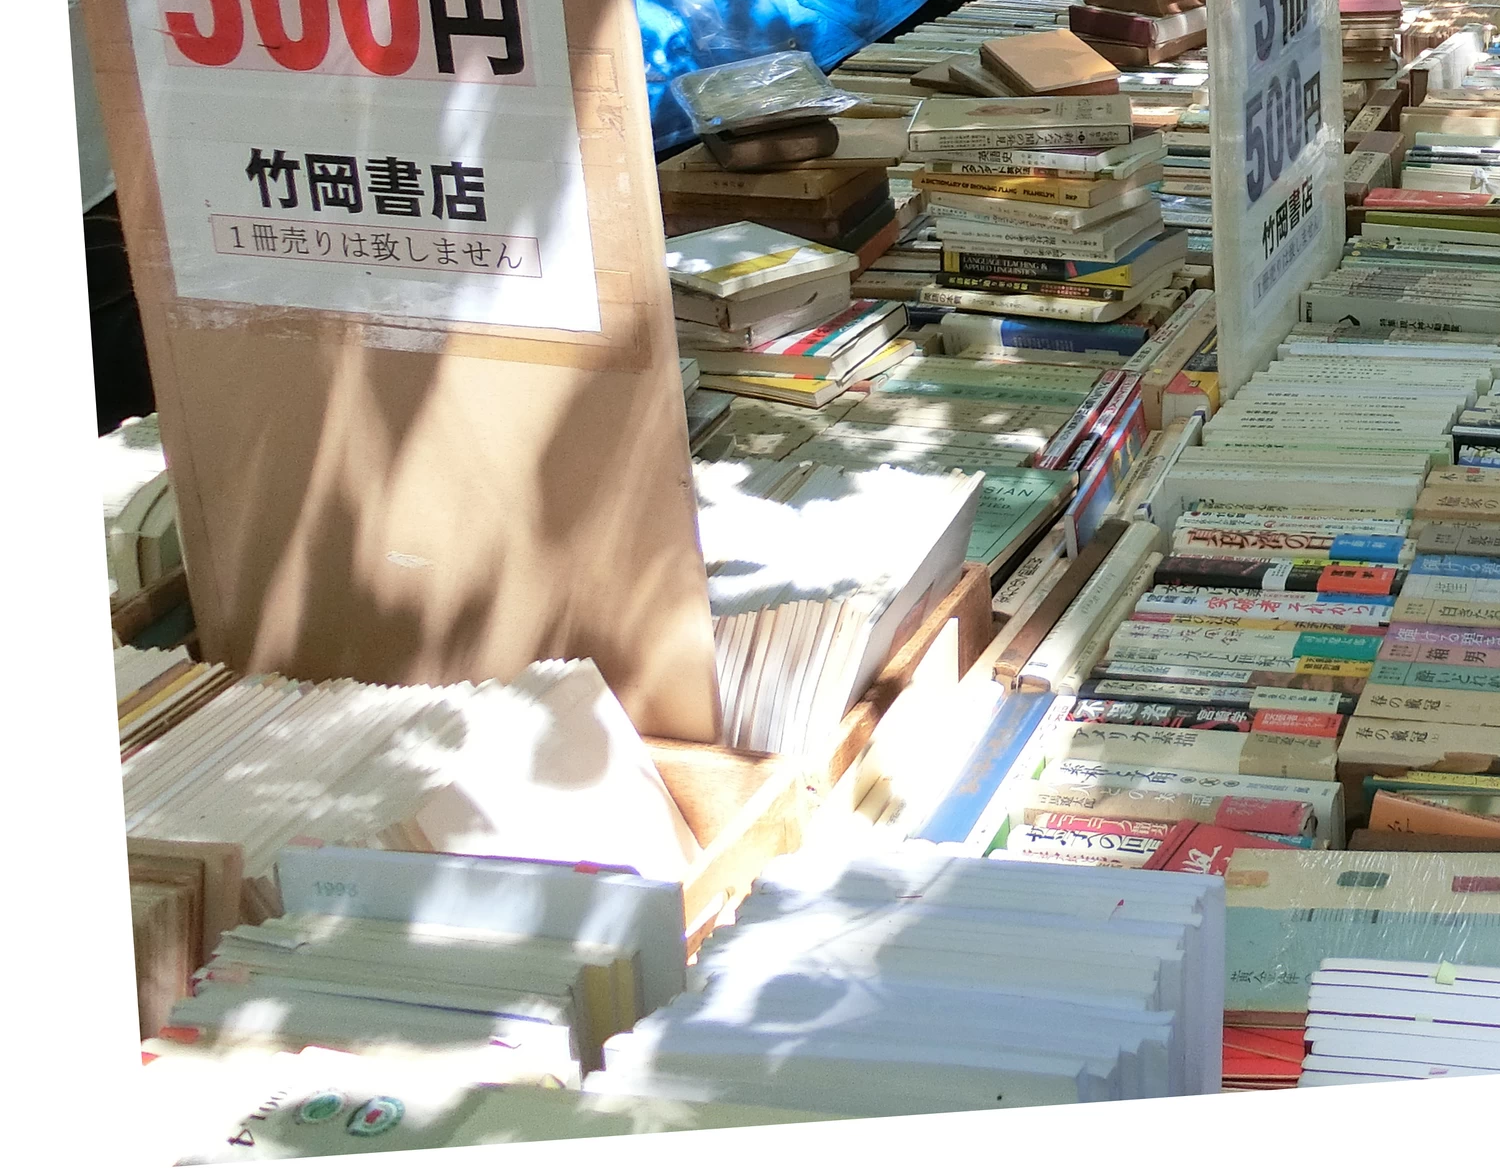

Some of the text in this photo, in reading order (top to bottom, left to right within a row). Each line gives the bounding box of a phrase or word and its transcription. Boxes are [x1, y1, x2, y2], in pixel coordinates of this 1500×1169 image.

[1244, 60, 1322, 202] 500円
[245, 147, 488, 222] 竹岡書店
[1261, 174, 1314, 260] 竹岡書店
[231, 225, 523, 270] 1冊売りは致しません
[963, 258, 1000, 268] LANGUAGE
[1002, 260, 1039, 270] TEACHING
[983, 485, 1034, 498] SIAN
[1425, 648, 1487, 664] 箱男
[1072, 728, 1198, 748] アメリカ素描
[1355, 727, 1429, 743] 春の戴冠
[1060, 759, 1178, 783] 素朴と文明
